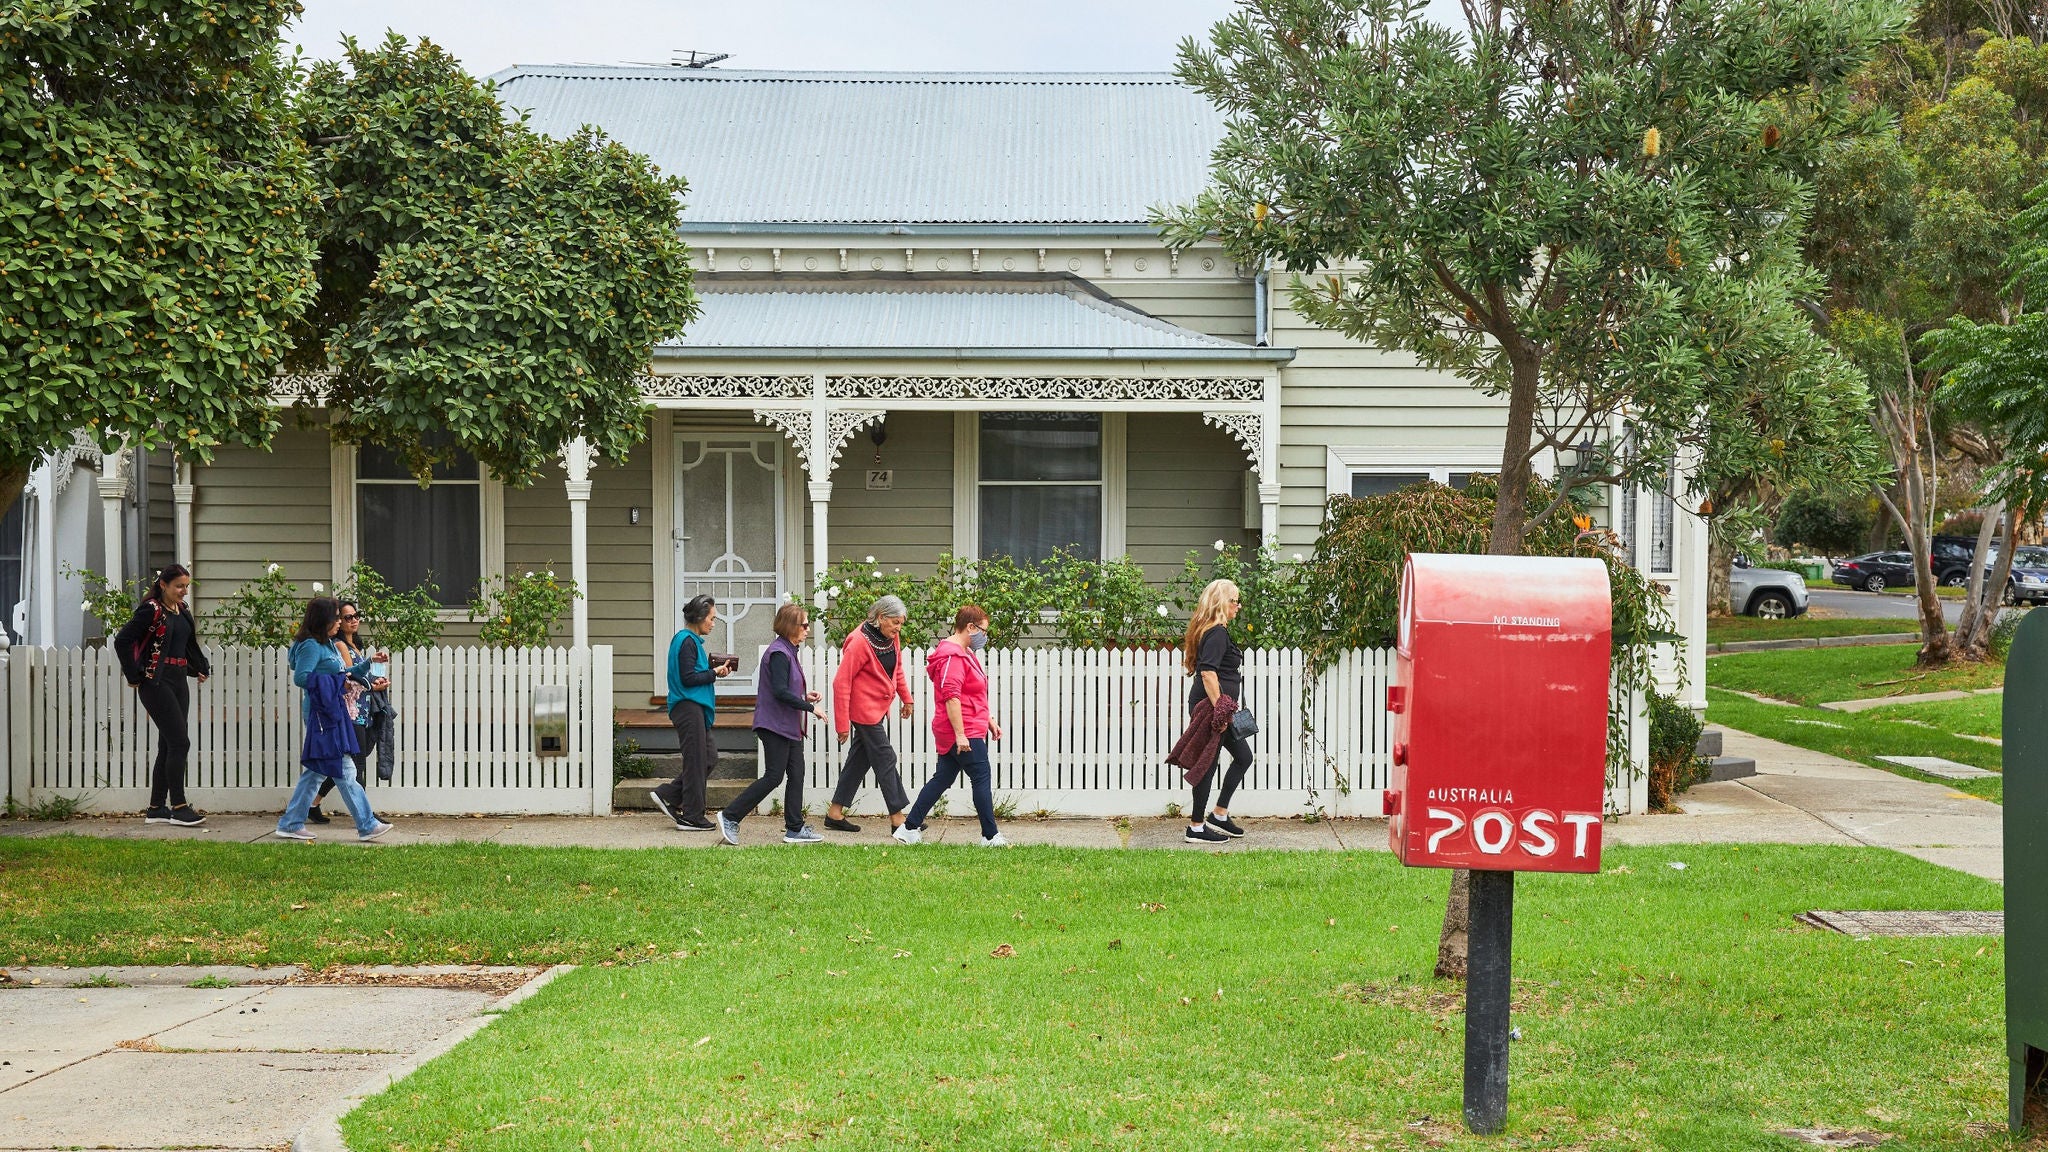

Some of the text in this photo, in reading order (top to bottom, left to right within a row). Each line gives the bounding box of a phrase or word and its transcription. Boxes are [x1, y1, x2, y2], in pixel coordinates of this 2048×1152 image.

[871, 471, 888, 482] 74
[1493, 615, 1560, 626] NO STANDING
[1428, 788, 1514, 804] AUSTRALIA
[1427, 807, 1600, 858] POST
